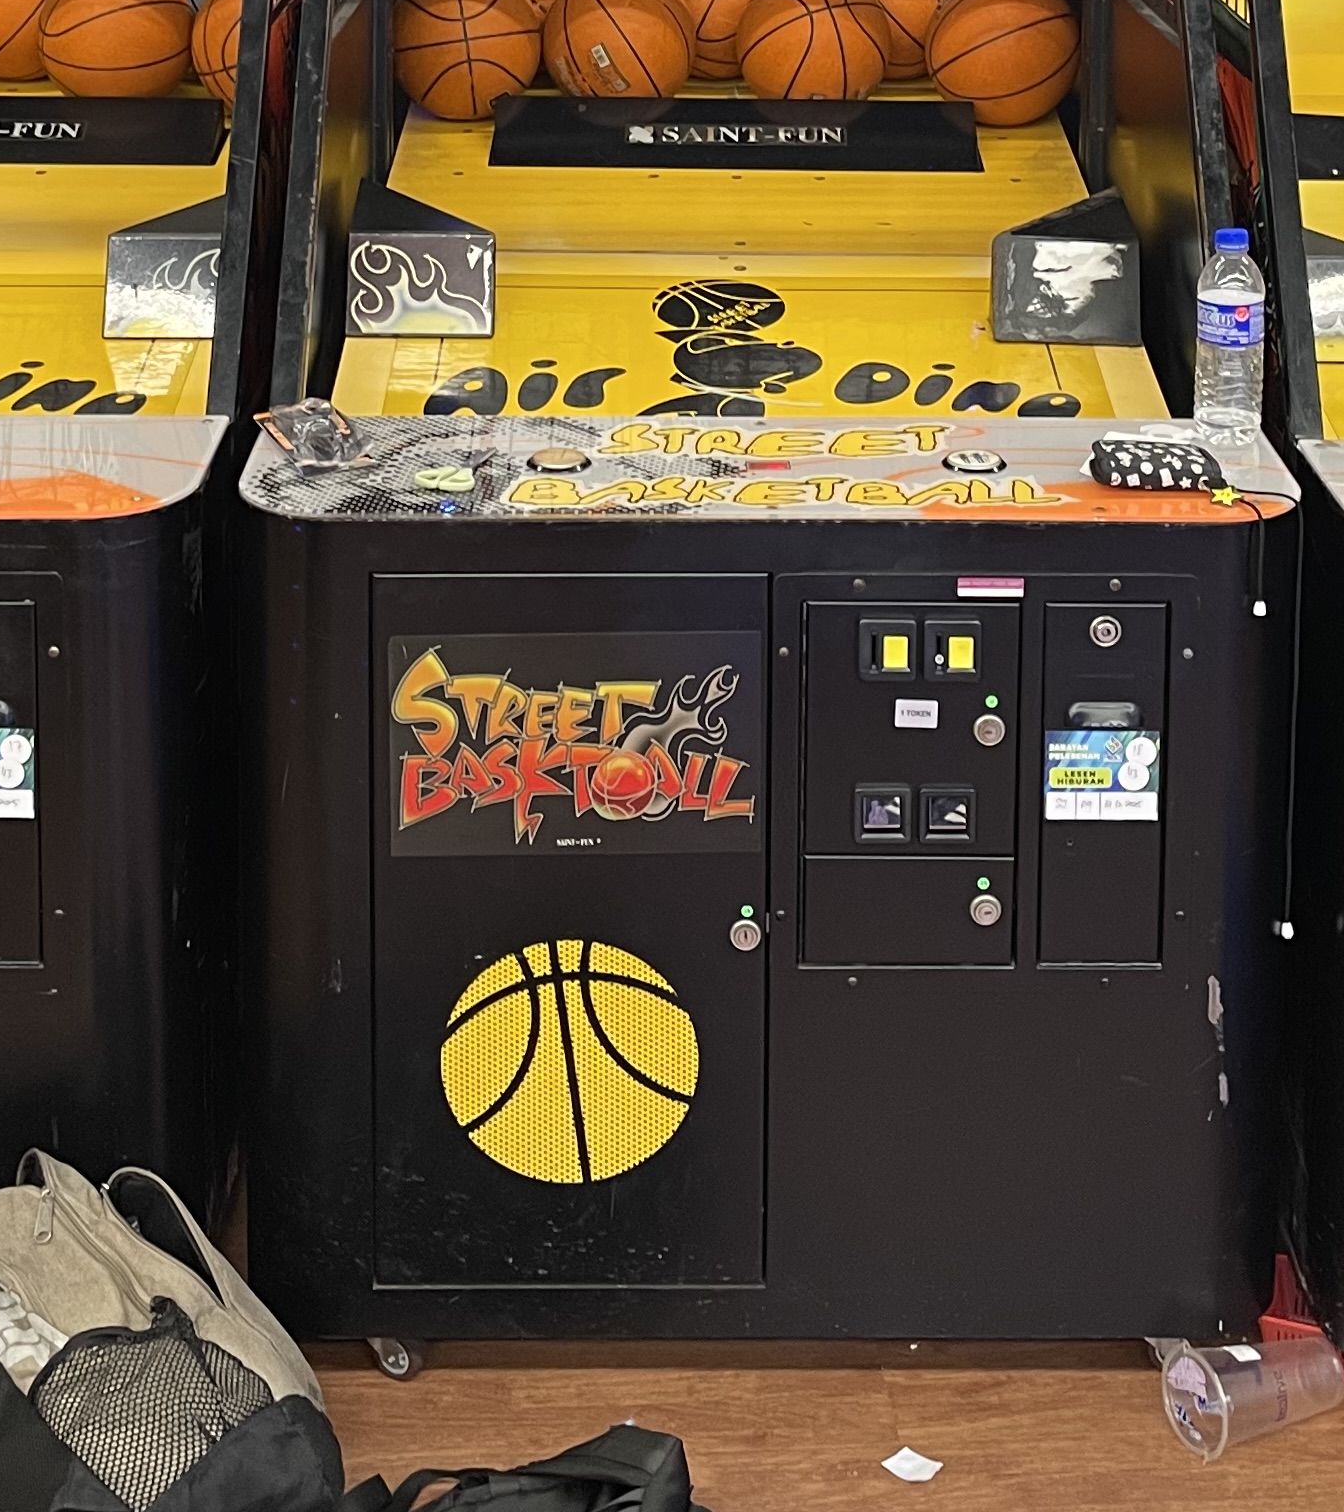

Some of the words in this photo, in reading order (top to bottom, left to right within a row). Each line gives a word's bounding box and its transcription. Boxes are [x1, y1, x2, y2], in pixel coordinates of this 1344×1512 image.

[661, 125, 844, 146] SAINT-FUN
[597, 423, 950, 460] STREET
[508, 475, 1064, 509] BASKETBALL
[391, 644, 662, 760] STREET
[906, 709, 932, 718] TOKEN
[1056, 778, 1105, 786] HIBURAN
[1064, 770, 1097, 778] LESEN
